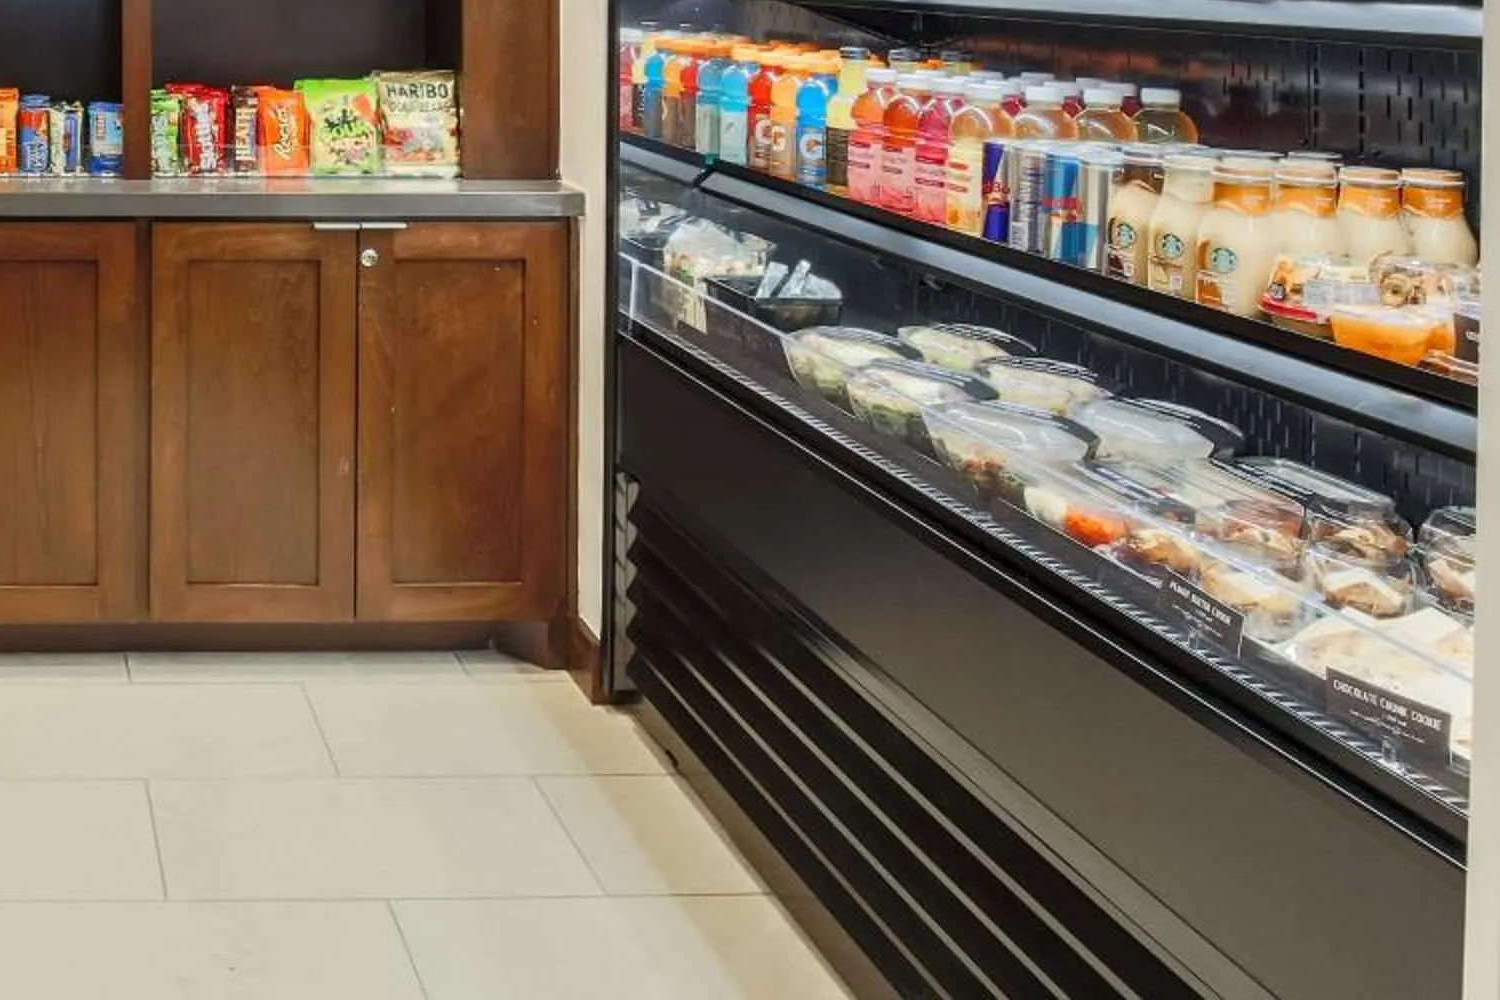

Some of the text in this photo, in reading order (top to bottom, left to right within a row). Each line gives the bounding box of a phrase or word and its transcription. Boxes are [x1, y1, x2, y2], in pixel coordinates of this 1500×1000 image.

[385, 83, 449, 99] HARIBO
[235, 107, 258, 162] HEATH
[1333, 679, 1378, 707] CHOCOLATE
[1411, 710, 1443, 732] COOKIE
